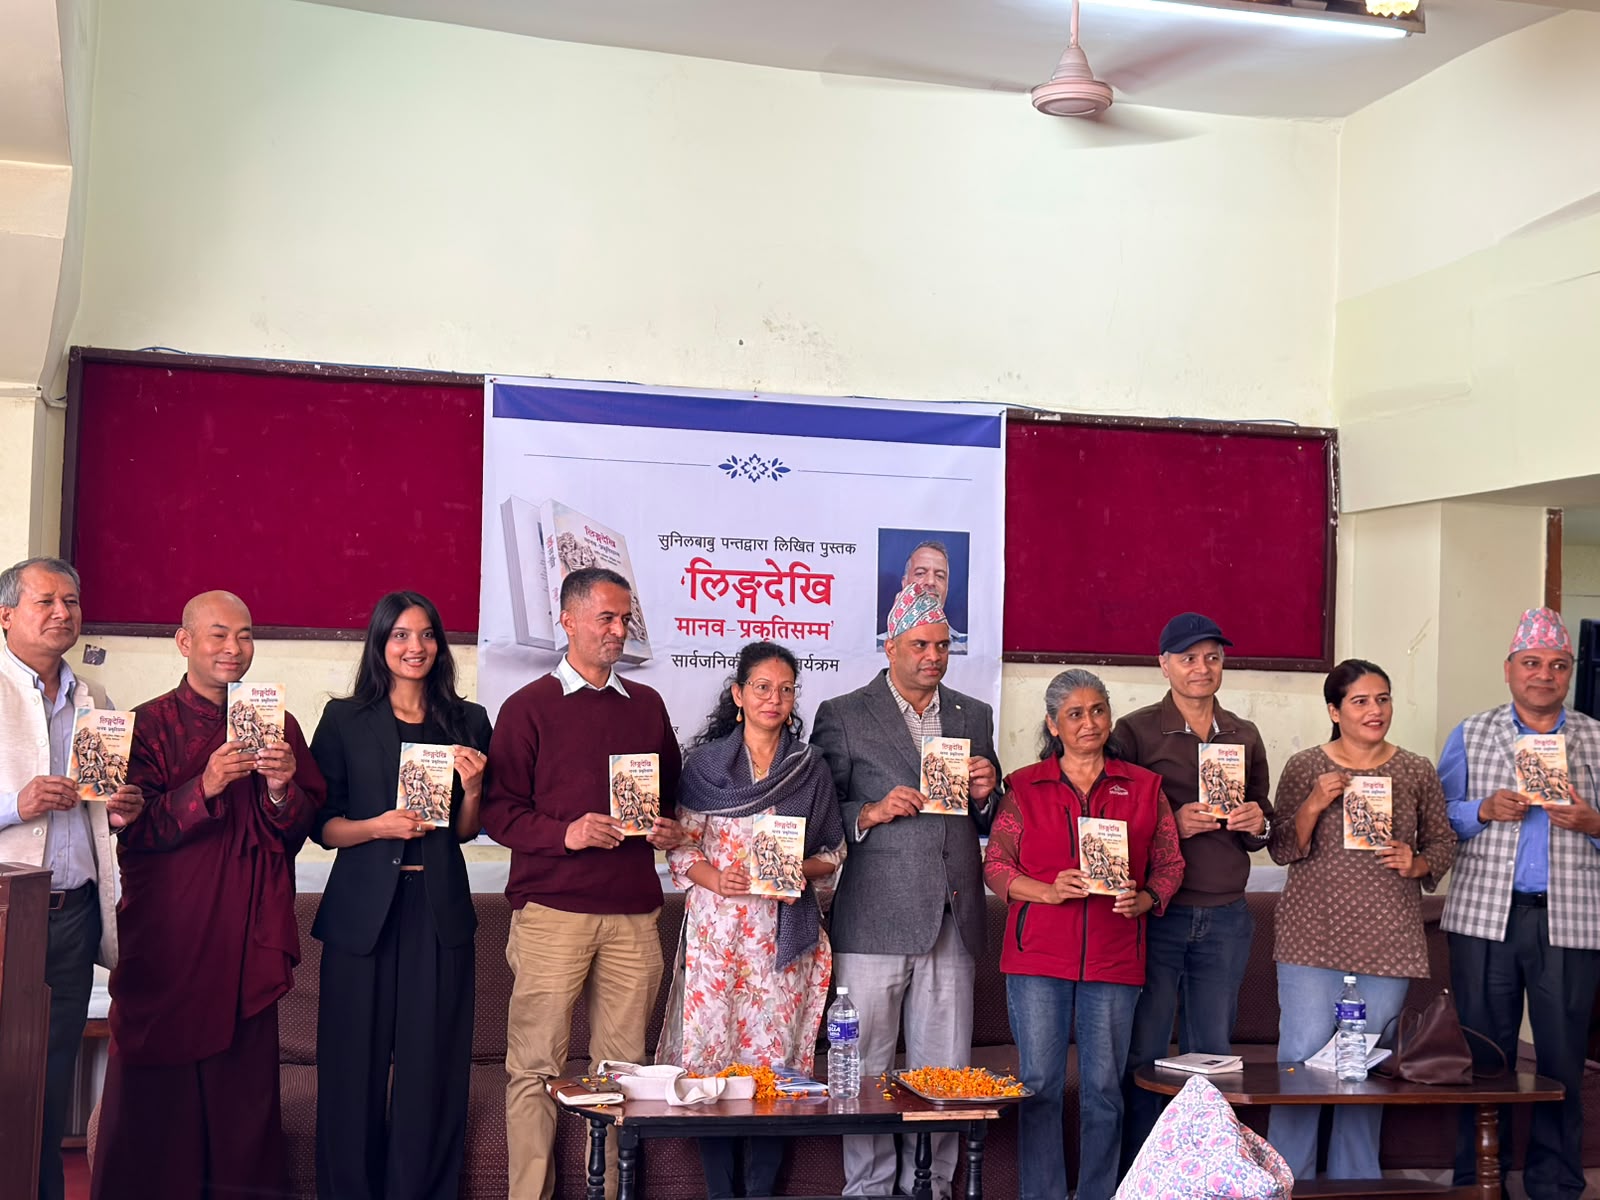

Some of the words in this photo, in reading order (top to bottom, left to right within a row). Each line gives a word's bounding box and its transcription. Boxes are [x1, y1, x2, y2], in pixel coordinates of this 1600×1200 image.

[658, 531, 716, 553] सुनिलबाबु
[720, 537, 769, 551] पन्तद्वारा
[774, 536, 815, 553] लिखित
[820, 542, 857, 558] पुस्तक
